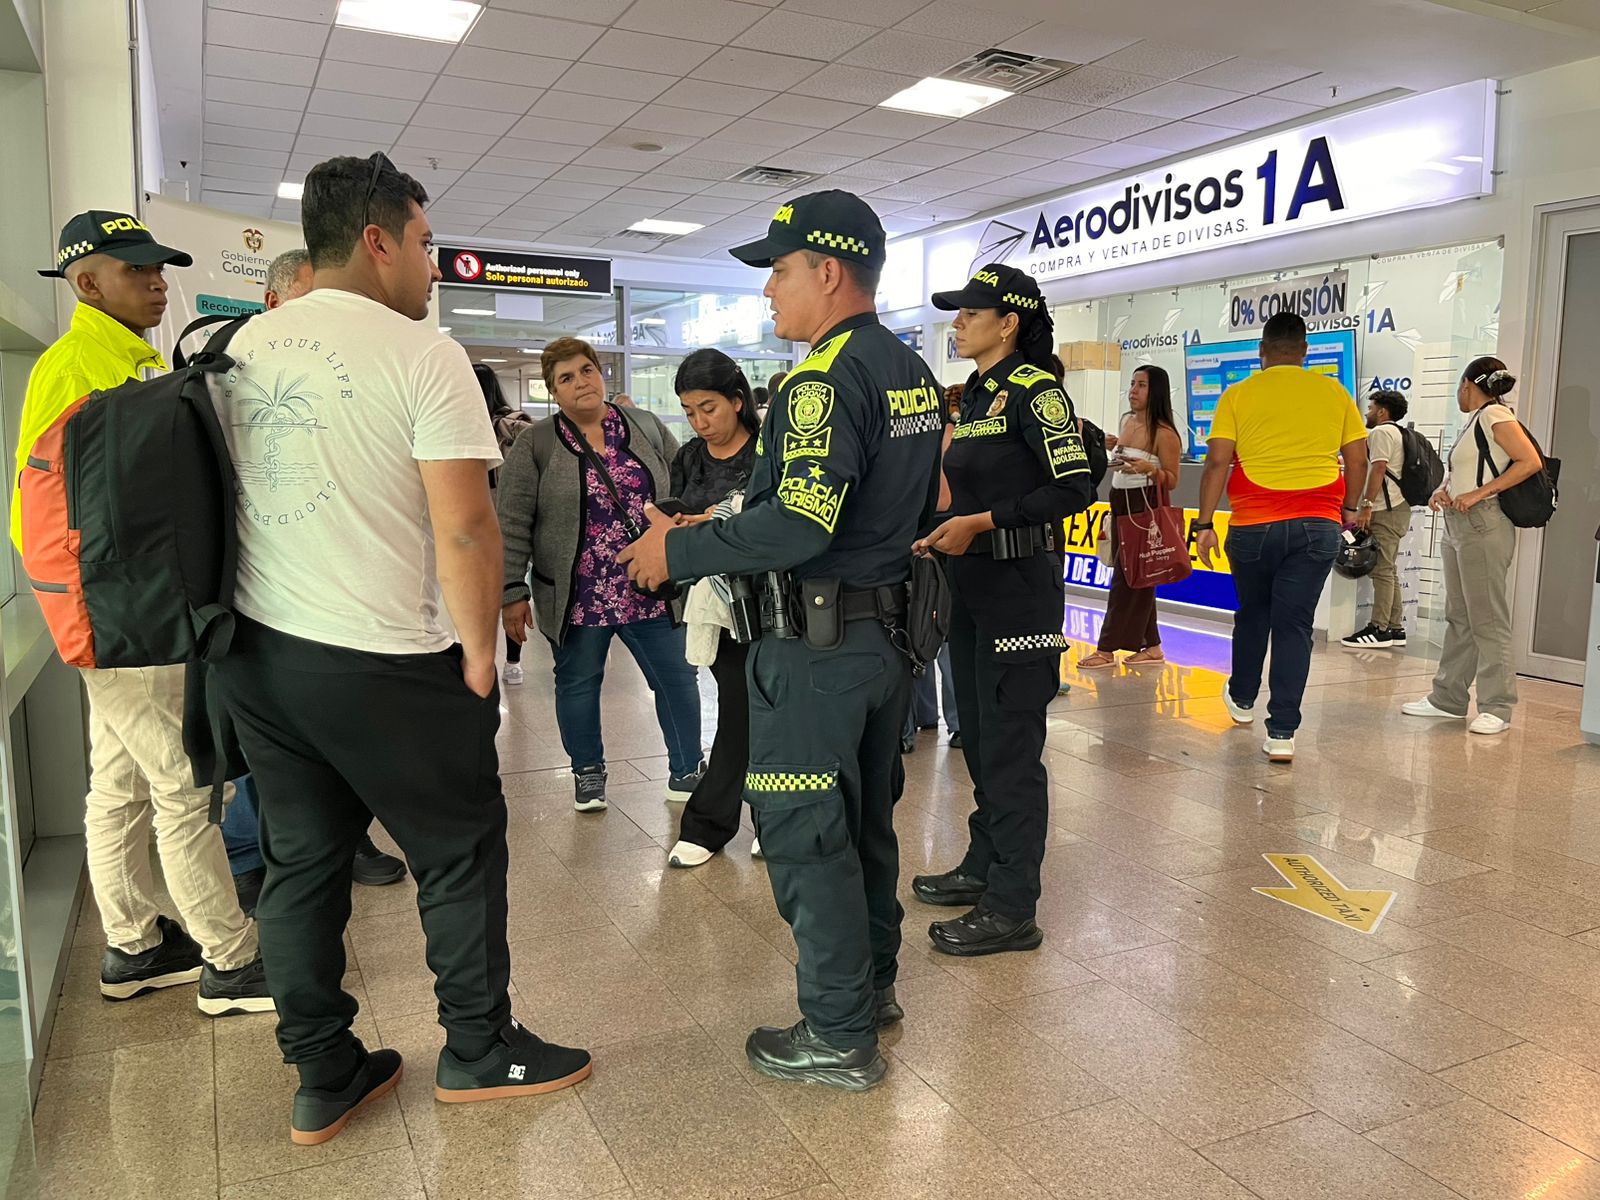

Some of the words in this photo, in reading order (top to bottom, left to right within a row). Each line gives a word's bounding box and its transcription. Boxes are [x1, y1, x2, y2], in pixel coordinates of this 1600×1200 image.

[1029, 169, 1244, 254] Aerodivisas
[1257, 136, 1344, 225] 1A
[101, 217, 145, 235] POL
[221, 250, 271, 266] Gobierno
[1030, 254, 1082, 275] COMPRA
[1088, 251, 1095, 263] Y
[1102, 240, 1147, 260] VENTA
[1152, 234, 1171, 250] DE
[222, 261, 267, 279] Colom
[485, 263, 526, 274] Authorized
[527, 267, 563, 276] personnel
[565, 270, 580, 279] only
[485, 271, 505, 282] Solo
[507, 275, 543, 286] personal
[546, 278, 589, 288] autorizado
[201, 300, 262, 316] Recomen
[1231, 295, 1255, 328] 0%
[1258, 276, 1346, 324] COMISIÓN
[1366, 307, 1396, 334] 1A
[1182, 327, 1201, 346] 1A
[224, 349, 255, 398] SURF
[268, 338, 321, 351] YOUR
[326, 351, 353, 399] LIFE
[886, 376, 939, 416] POLICÍA
[1368, 375, 1412, 391] Aero
[1053, 444, 1083, 457] INFANCIA
[235, 480, 337, 526] CLOUDBREA
[782, 477, 838, 509] POLICÍA
[1071, 556, 1095, 583] DE
[1282, 856, 1341, 902] AUTHORIZED
[1331, 903, 1365, 922] TAXI
